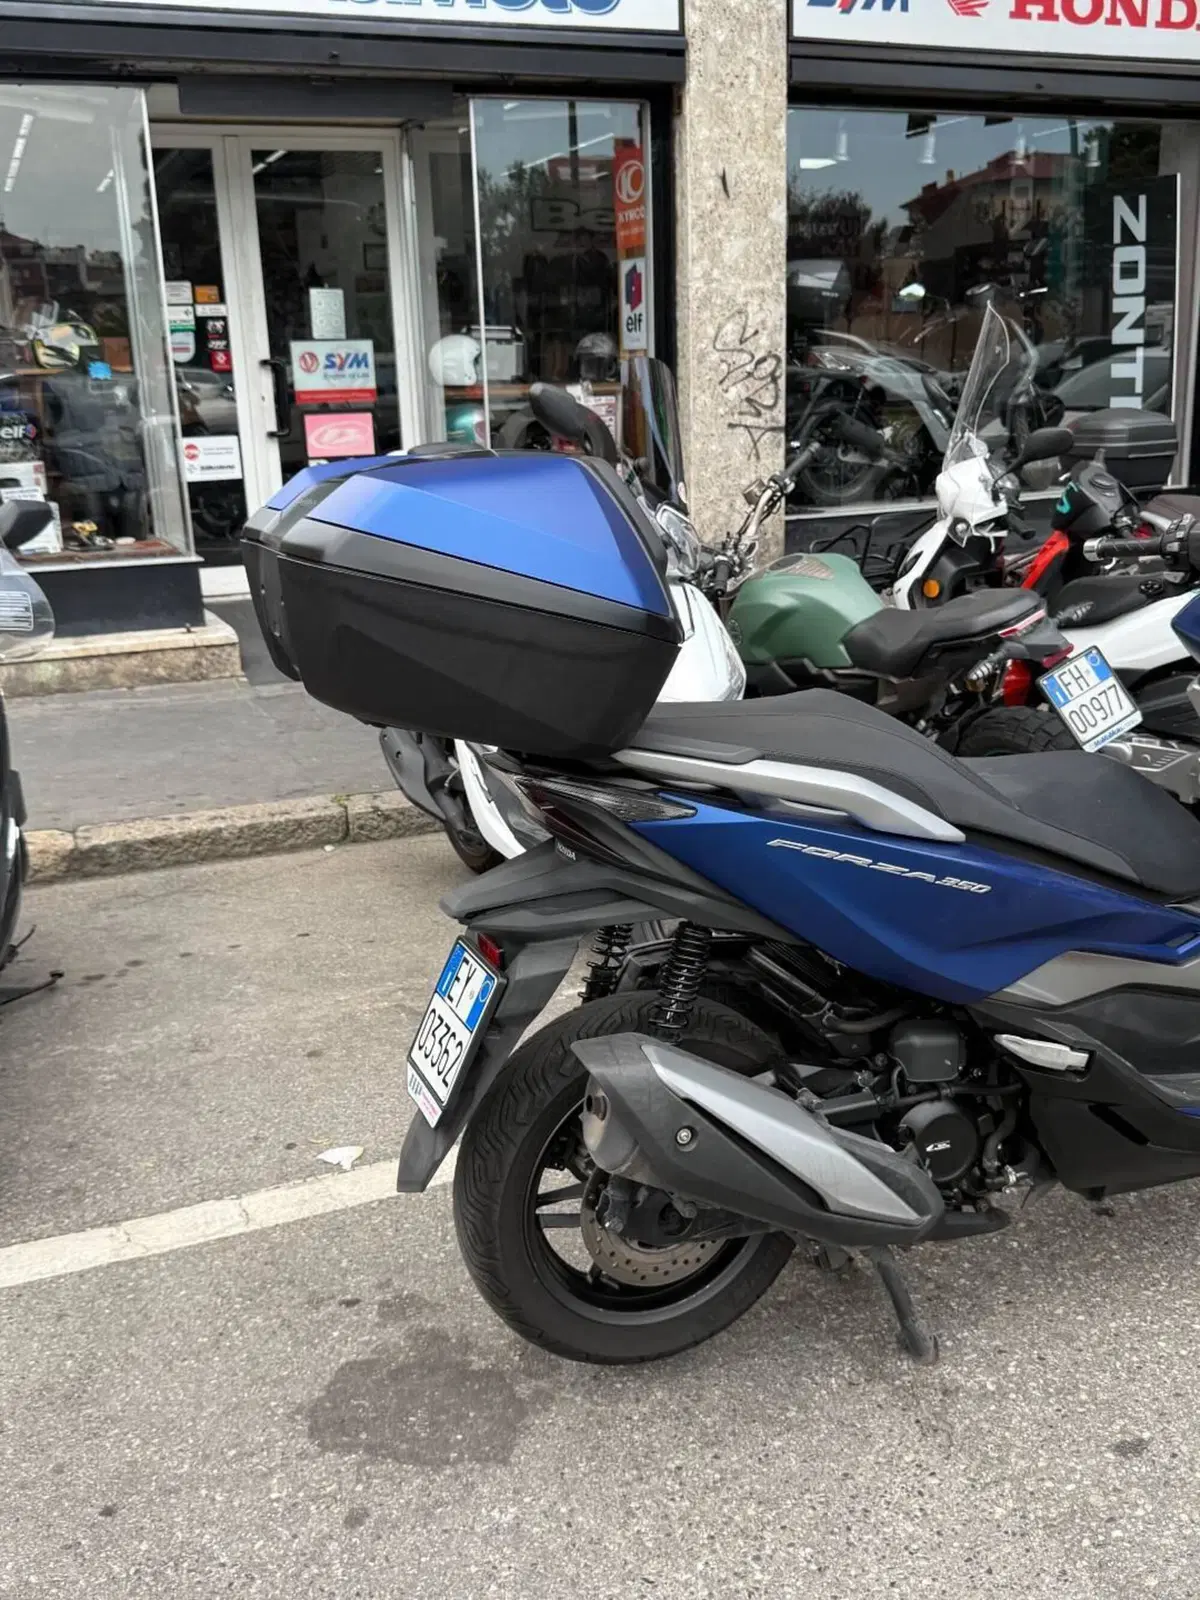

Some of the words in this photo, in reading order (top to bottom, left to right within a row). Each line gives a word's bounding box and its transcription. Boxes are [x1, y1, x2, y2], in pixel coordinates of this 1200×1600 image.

[1009, 0, 1200, 31] HOND
[626, 312, 643, 333] elf
[1109, 194, 1147, 410] ZONT
[323, 352, 369, 372] SYM
[0, 424, 26, 439] elf
[1058, 664, 1090, 698] FH
[1068, 683, 1123, 734] 00977
[766, 838, 936, 883] FORZA
[935, 876, 992, 894] 350
[446, 956, 477, 1009] EY
[418, 1008, 464, 1088] 03362
